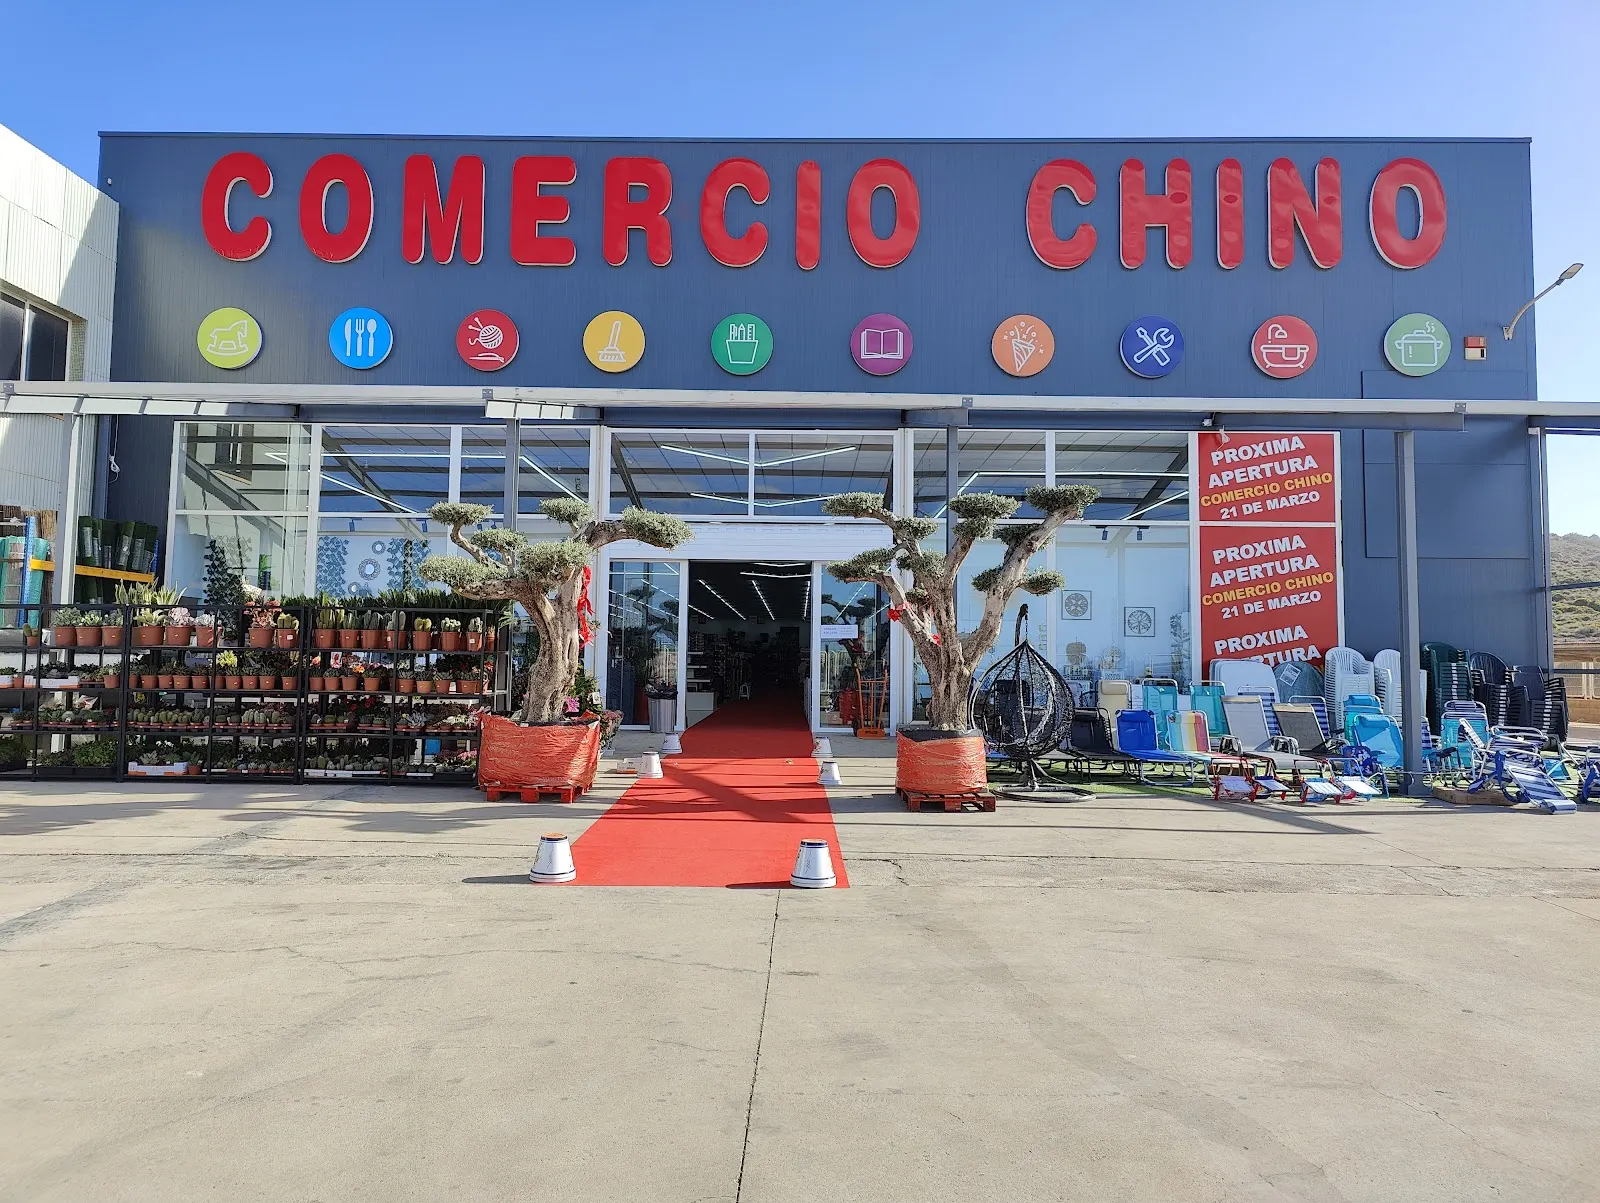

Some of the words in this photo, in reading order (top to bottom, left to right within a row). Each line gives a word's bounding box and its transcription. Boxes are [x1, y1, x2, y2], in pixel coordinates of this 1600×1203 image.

[201, 151, 921, 270] COMERCIO
[1026, 157, 1449, 271] CHINO
[1211, 435, 1305, 467] PROXIMA
[1208, 455, 1319, 489] APERTURA
[1200, 482, 1281, 507] COMERCIO
[1284, 472, 1333, 492] CHINO
[1220, 505, 1238, 520] 21
[1242, 499, 1263, 516] DE
[1266, 490, 1321, 511] MARZO
[1213, 534, 1307, 565] PROXIMA
[1210, 554, 1320, 588] APERTURA
[1202, 581, 1282, 606] COMERCIO
[1285, 571, 1335, 590] CHINO
[1221, 605, 1240, 619] 21
[1243, 599, 1265, 616] DE
[1268, 590, 1322, 611] MARZO
[1214, 624, 1308, 656] PROXIMA
